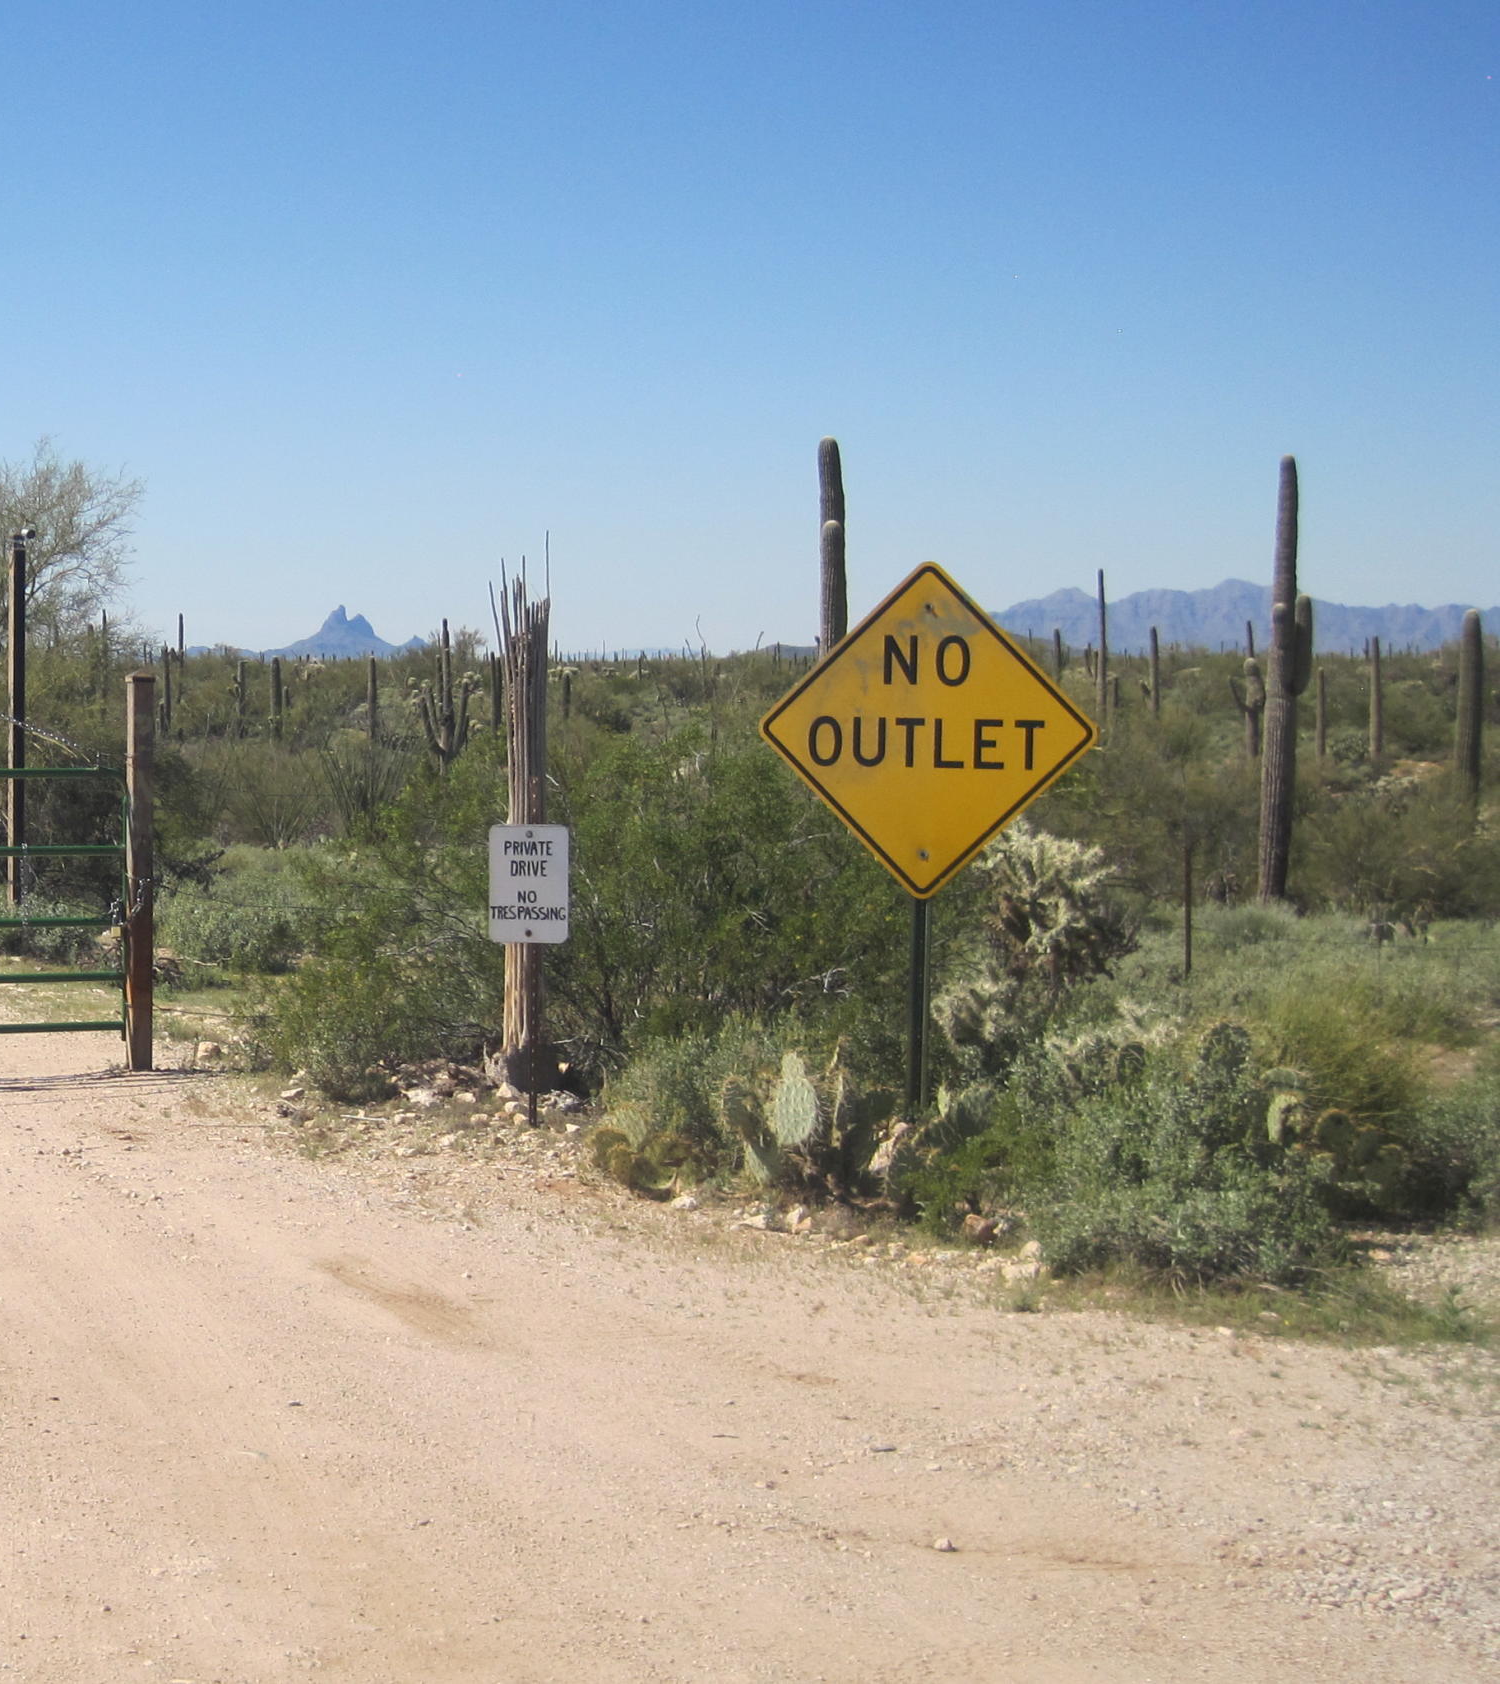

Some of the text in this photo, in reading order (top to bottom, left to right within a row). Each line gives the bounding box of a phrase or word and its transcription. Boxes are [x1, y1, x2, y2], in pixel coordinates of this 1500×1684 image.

[883, 634, 971, 687] NO
[807, 715, 1046, 771] OUTLET
[503, 840, 553, 856] PRIVATE
[510, 860, 548, 877] DRIVE
[517, 890, 538, 904] NO
[490, 905, 567, 921] TRESPASSING
